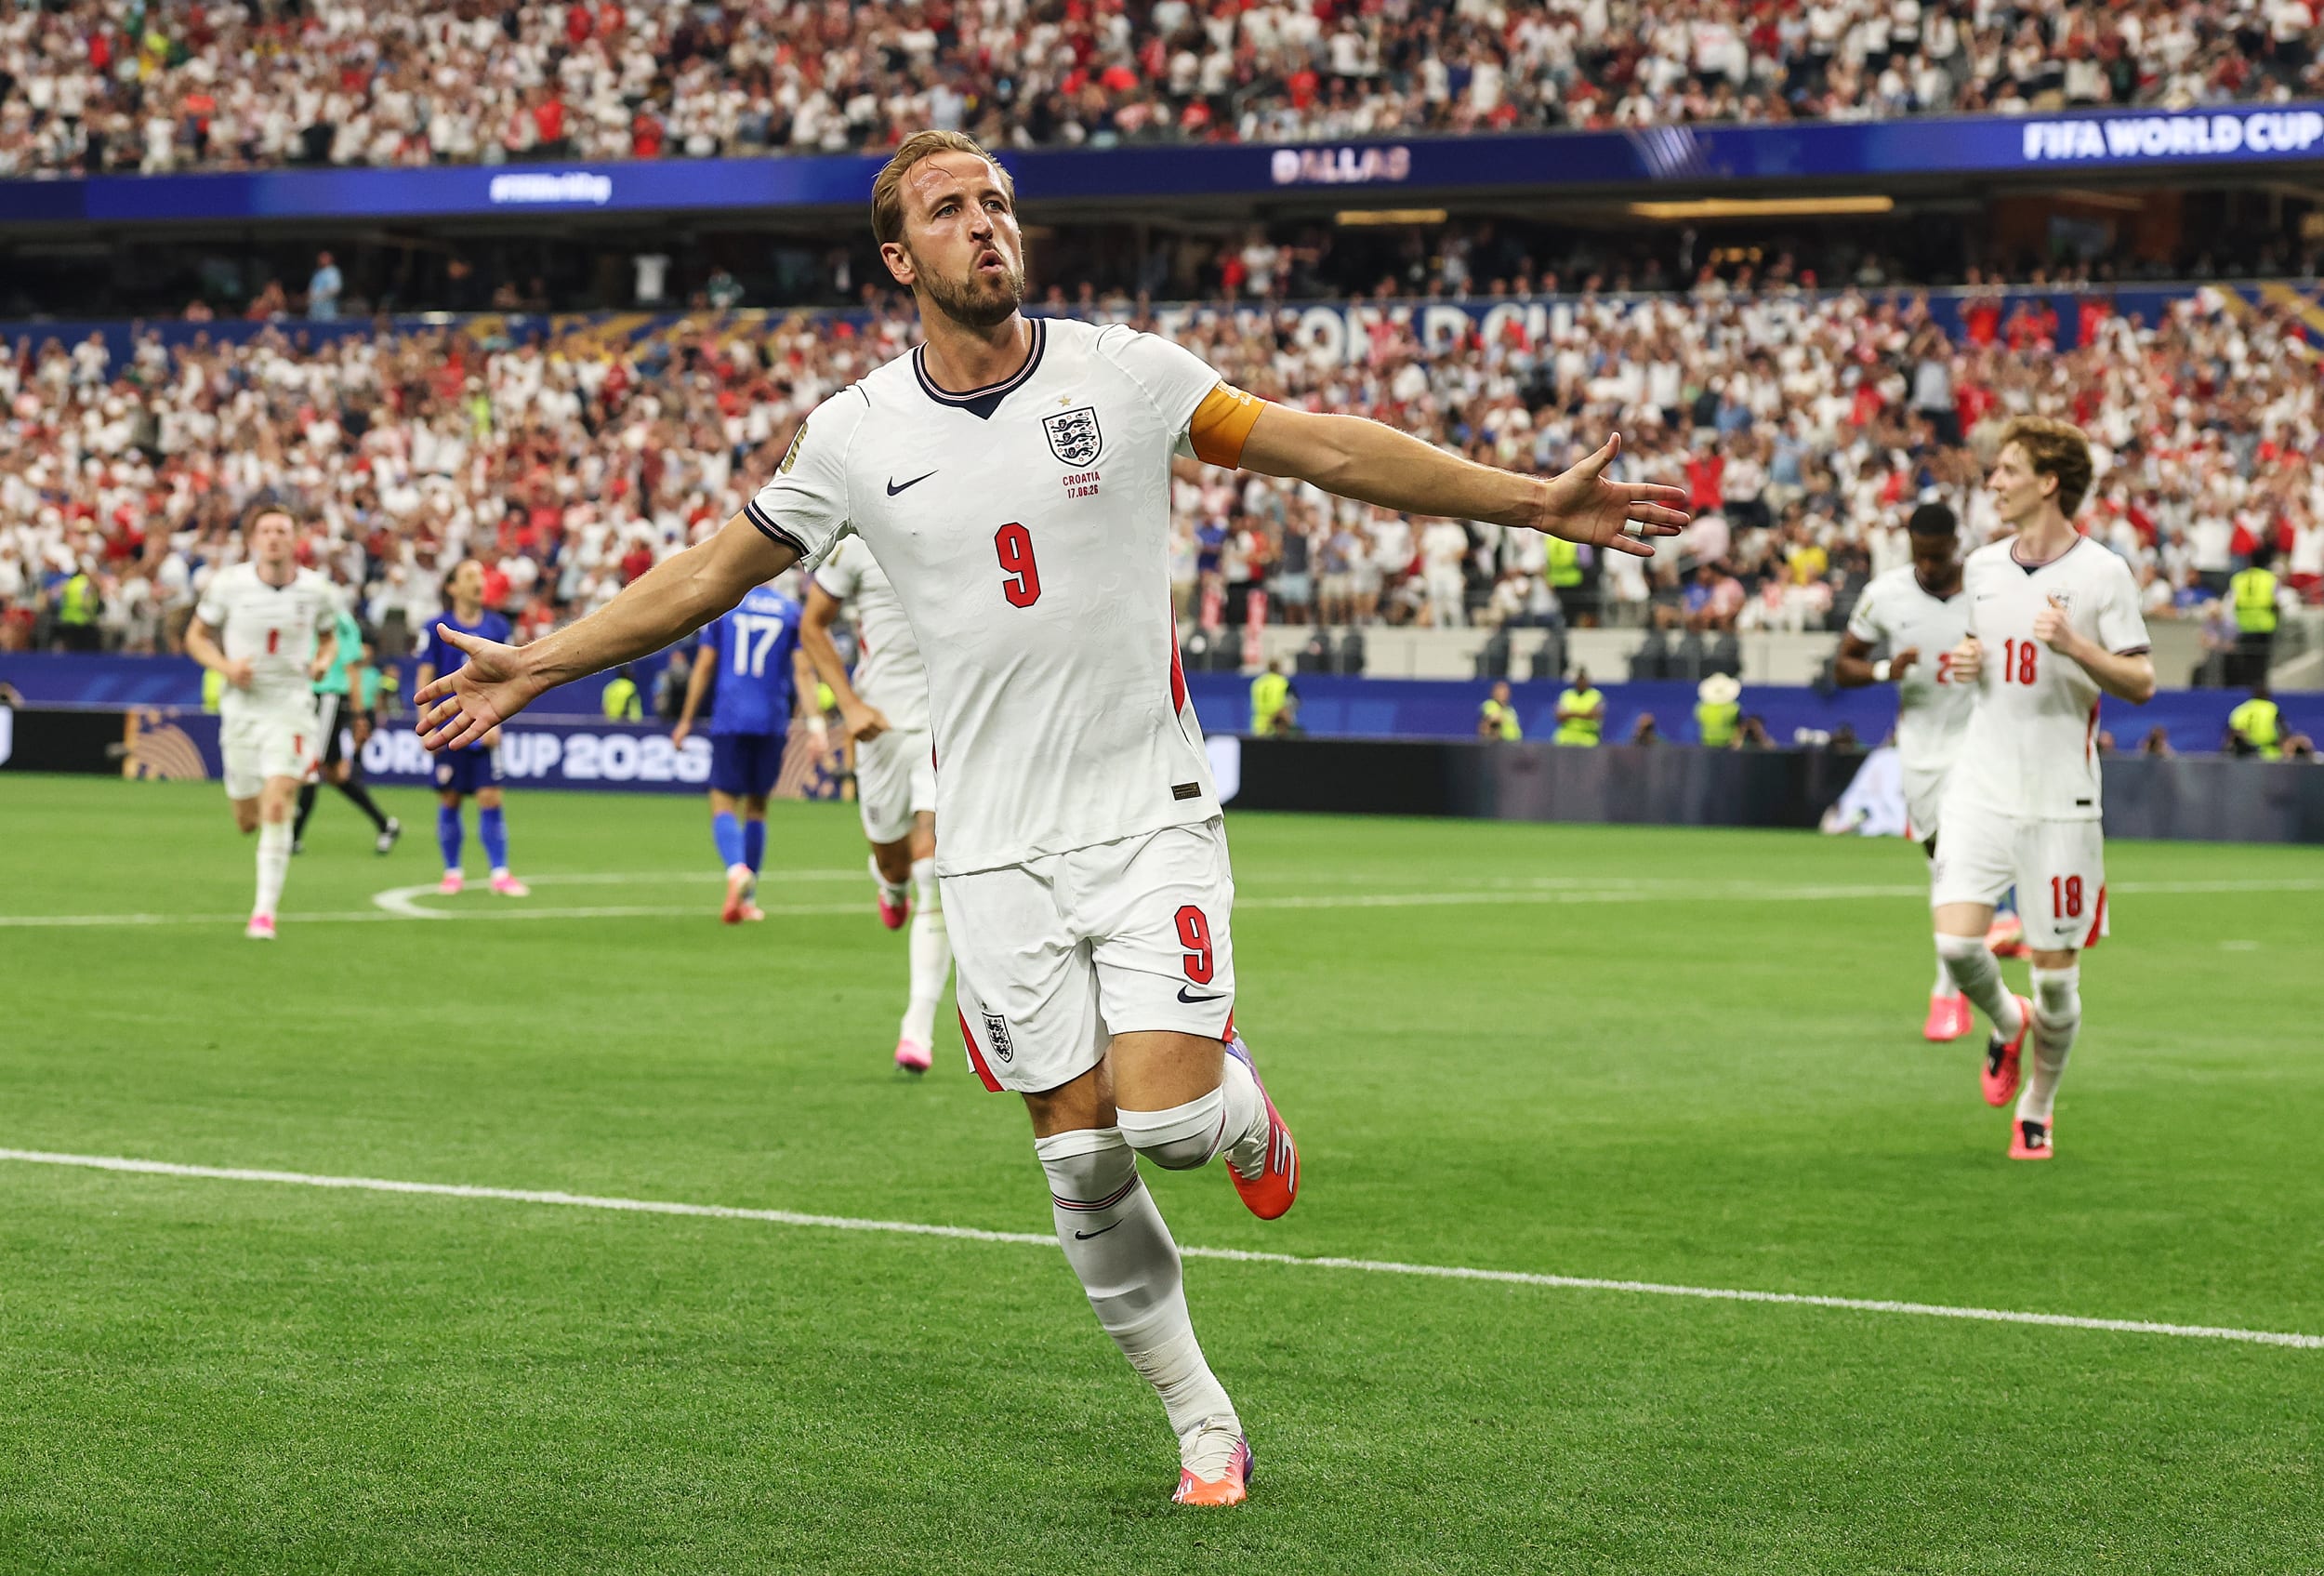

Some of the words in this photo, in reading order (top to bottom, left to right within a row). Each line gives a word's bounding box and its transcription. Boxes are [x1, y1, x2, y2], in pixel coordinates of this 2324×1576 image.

[2022, 119, 2107, 161] FIFA
[2103, 115, 2243, 157] WORLD
[2244, 111, 2323, 152] CUP
[1063, 470, 1101, 486] CROATIA
[1067, 483, 1099, 499] 17.06.26
[994, 522, 1041, 609] 9
[733, 614, 784, 678] 17
[2004, 638, 2038, 685] 18
[501, 732, 562, 779] UP
[561, 733, 714, 783] 2026
[2051, 875, 2083, 919] 18
[1174, 905, 1214, 986] 9
